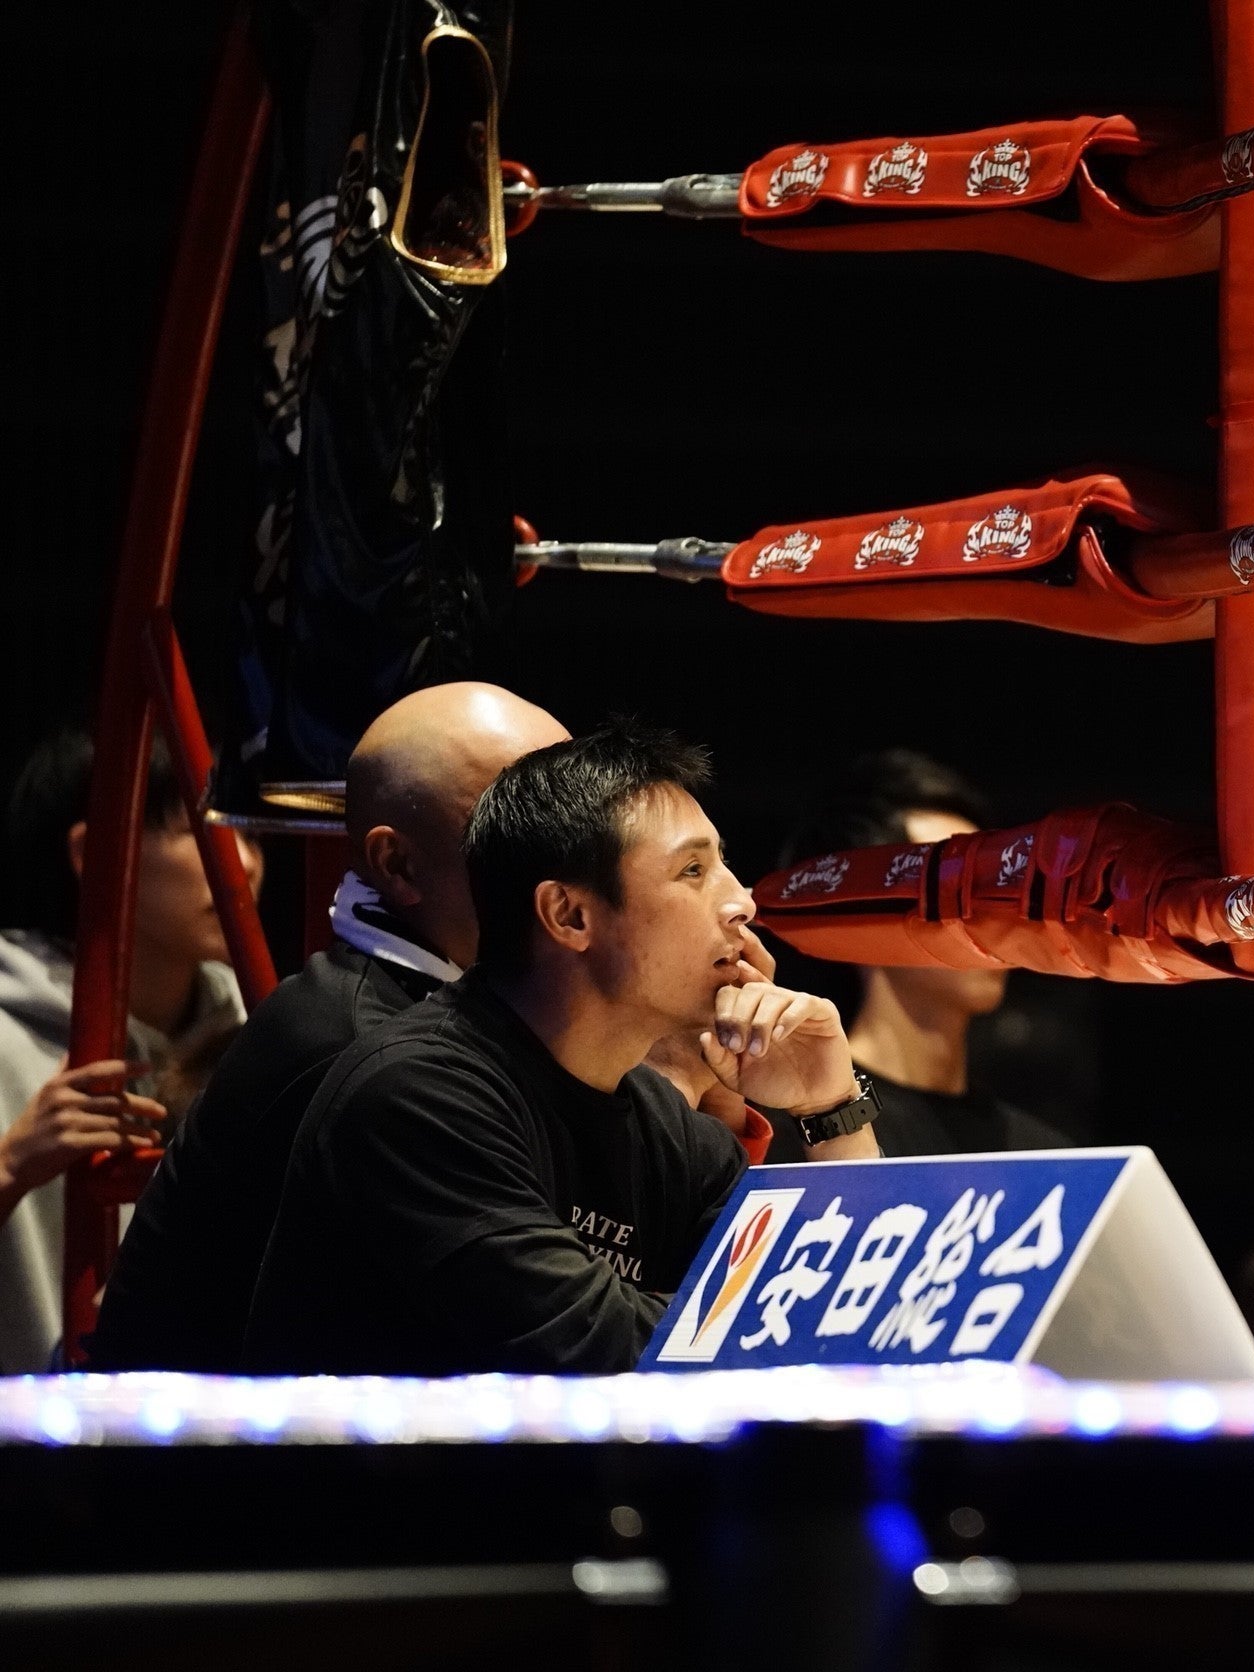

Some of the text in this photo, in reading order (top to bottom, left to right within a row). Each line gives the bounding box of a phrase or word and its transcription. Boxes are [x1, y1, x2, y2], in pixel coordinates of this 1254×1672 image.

[994, 153, 1013, 162] TOP
[781, 164, 817, 191] KING
[878, 159, 914, 180] KING
[982, 160, 1021, 181] KING
[994, 519, 1016, 530] TOP
[872, 534, 912, 555] KING
[980, 525, 1020, 548] KING
[766, 544, 808, 564] KING
[739, 1184, 1066, 1356] 安田総合
